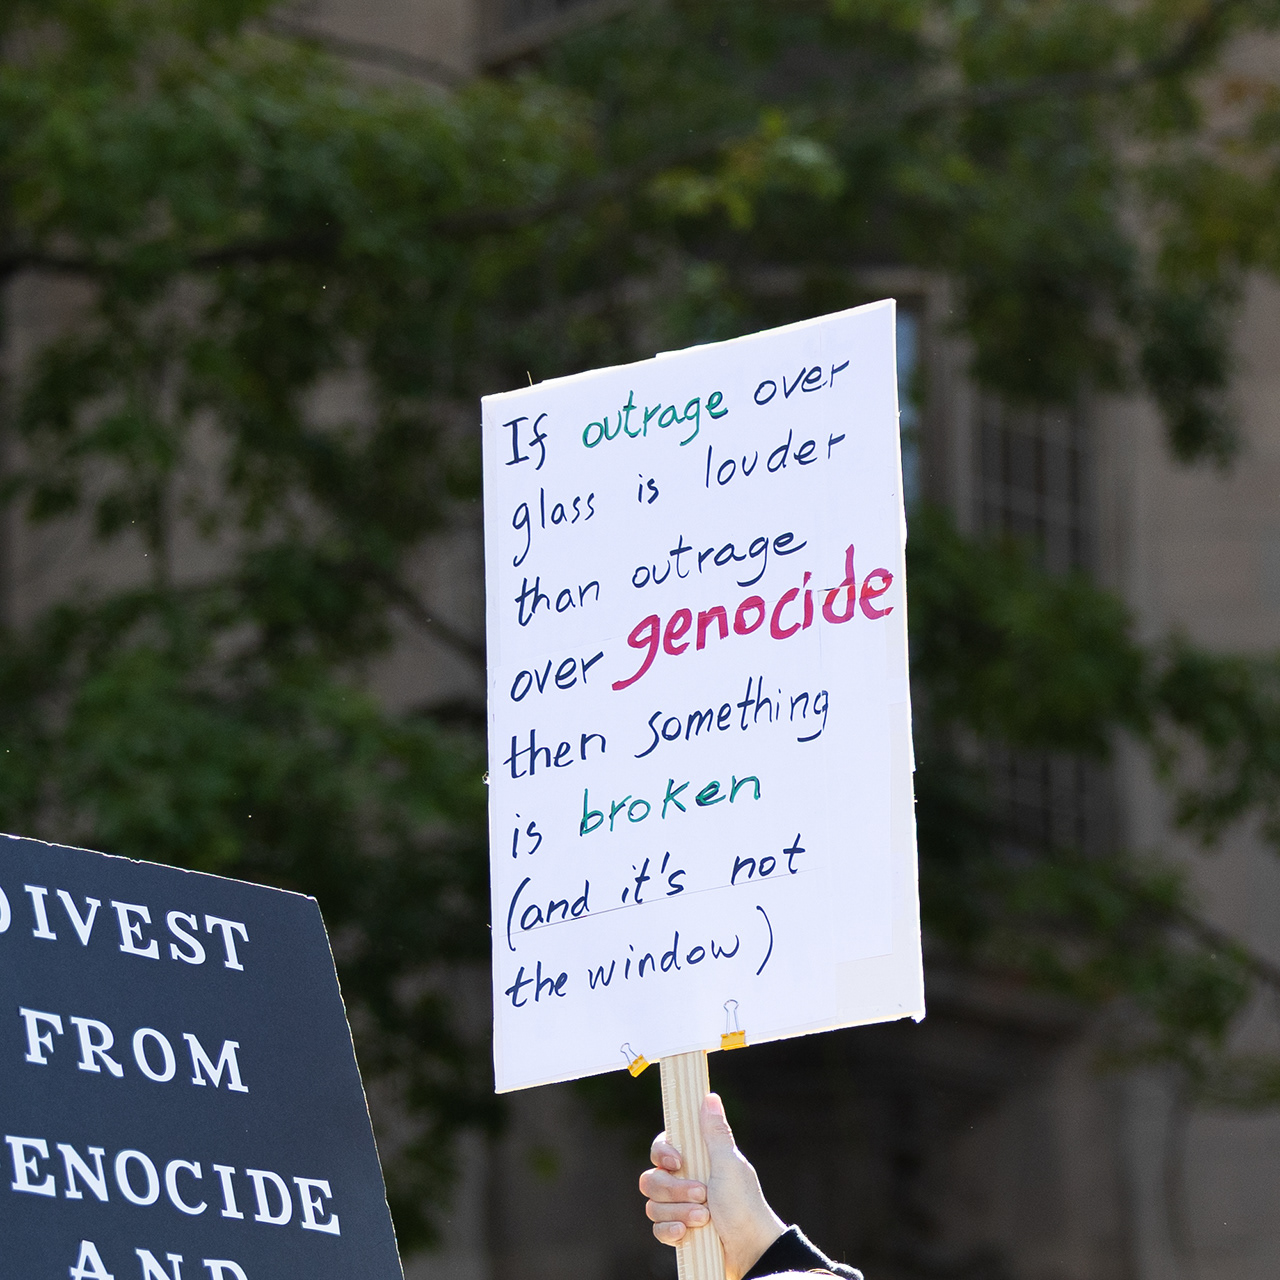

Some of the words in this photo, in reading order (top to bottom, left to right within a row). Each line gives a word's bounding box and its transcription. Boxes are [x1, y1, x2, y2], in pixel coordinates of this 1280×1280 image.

[502, 413, 548, 470] If
[583, 390, 728, 448] outrage
[754, 360, 849, 405] over
[512, 488, 594, 567] glass
[638, 474, 660, 504] is
[706, 429, 845, 488] louder
[511, 651, 604, 702] over
[612, 544, 894, 690] genocide
[515, 576, 599, 626] than
[632, 529, 807, 588] outrage
[503, 729, 606, 778] then
[634, 676, 829, 758] something
[512, 814, 543, 858] is
[580, 776, 760, 837] broken
[507, 877, 590, 951] (and
[622, 852, 686, 904] it's
[731, 833, 805, 886] not
[505, 961, 568, 1007] the
[588, 906, 773, 989] window)
[20, 1008, 248, 1092] FROM
